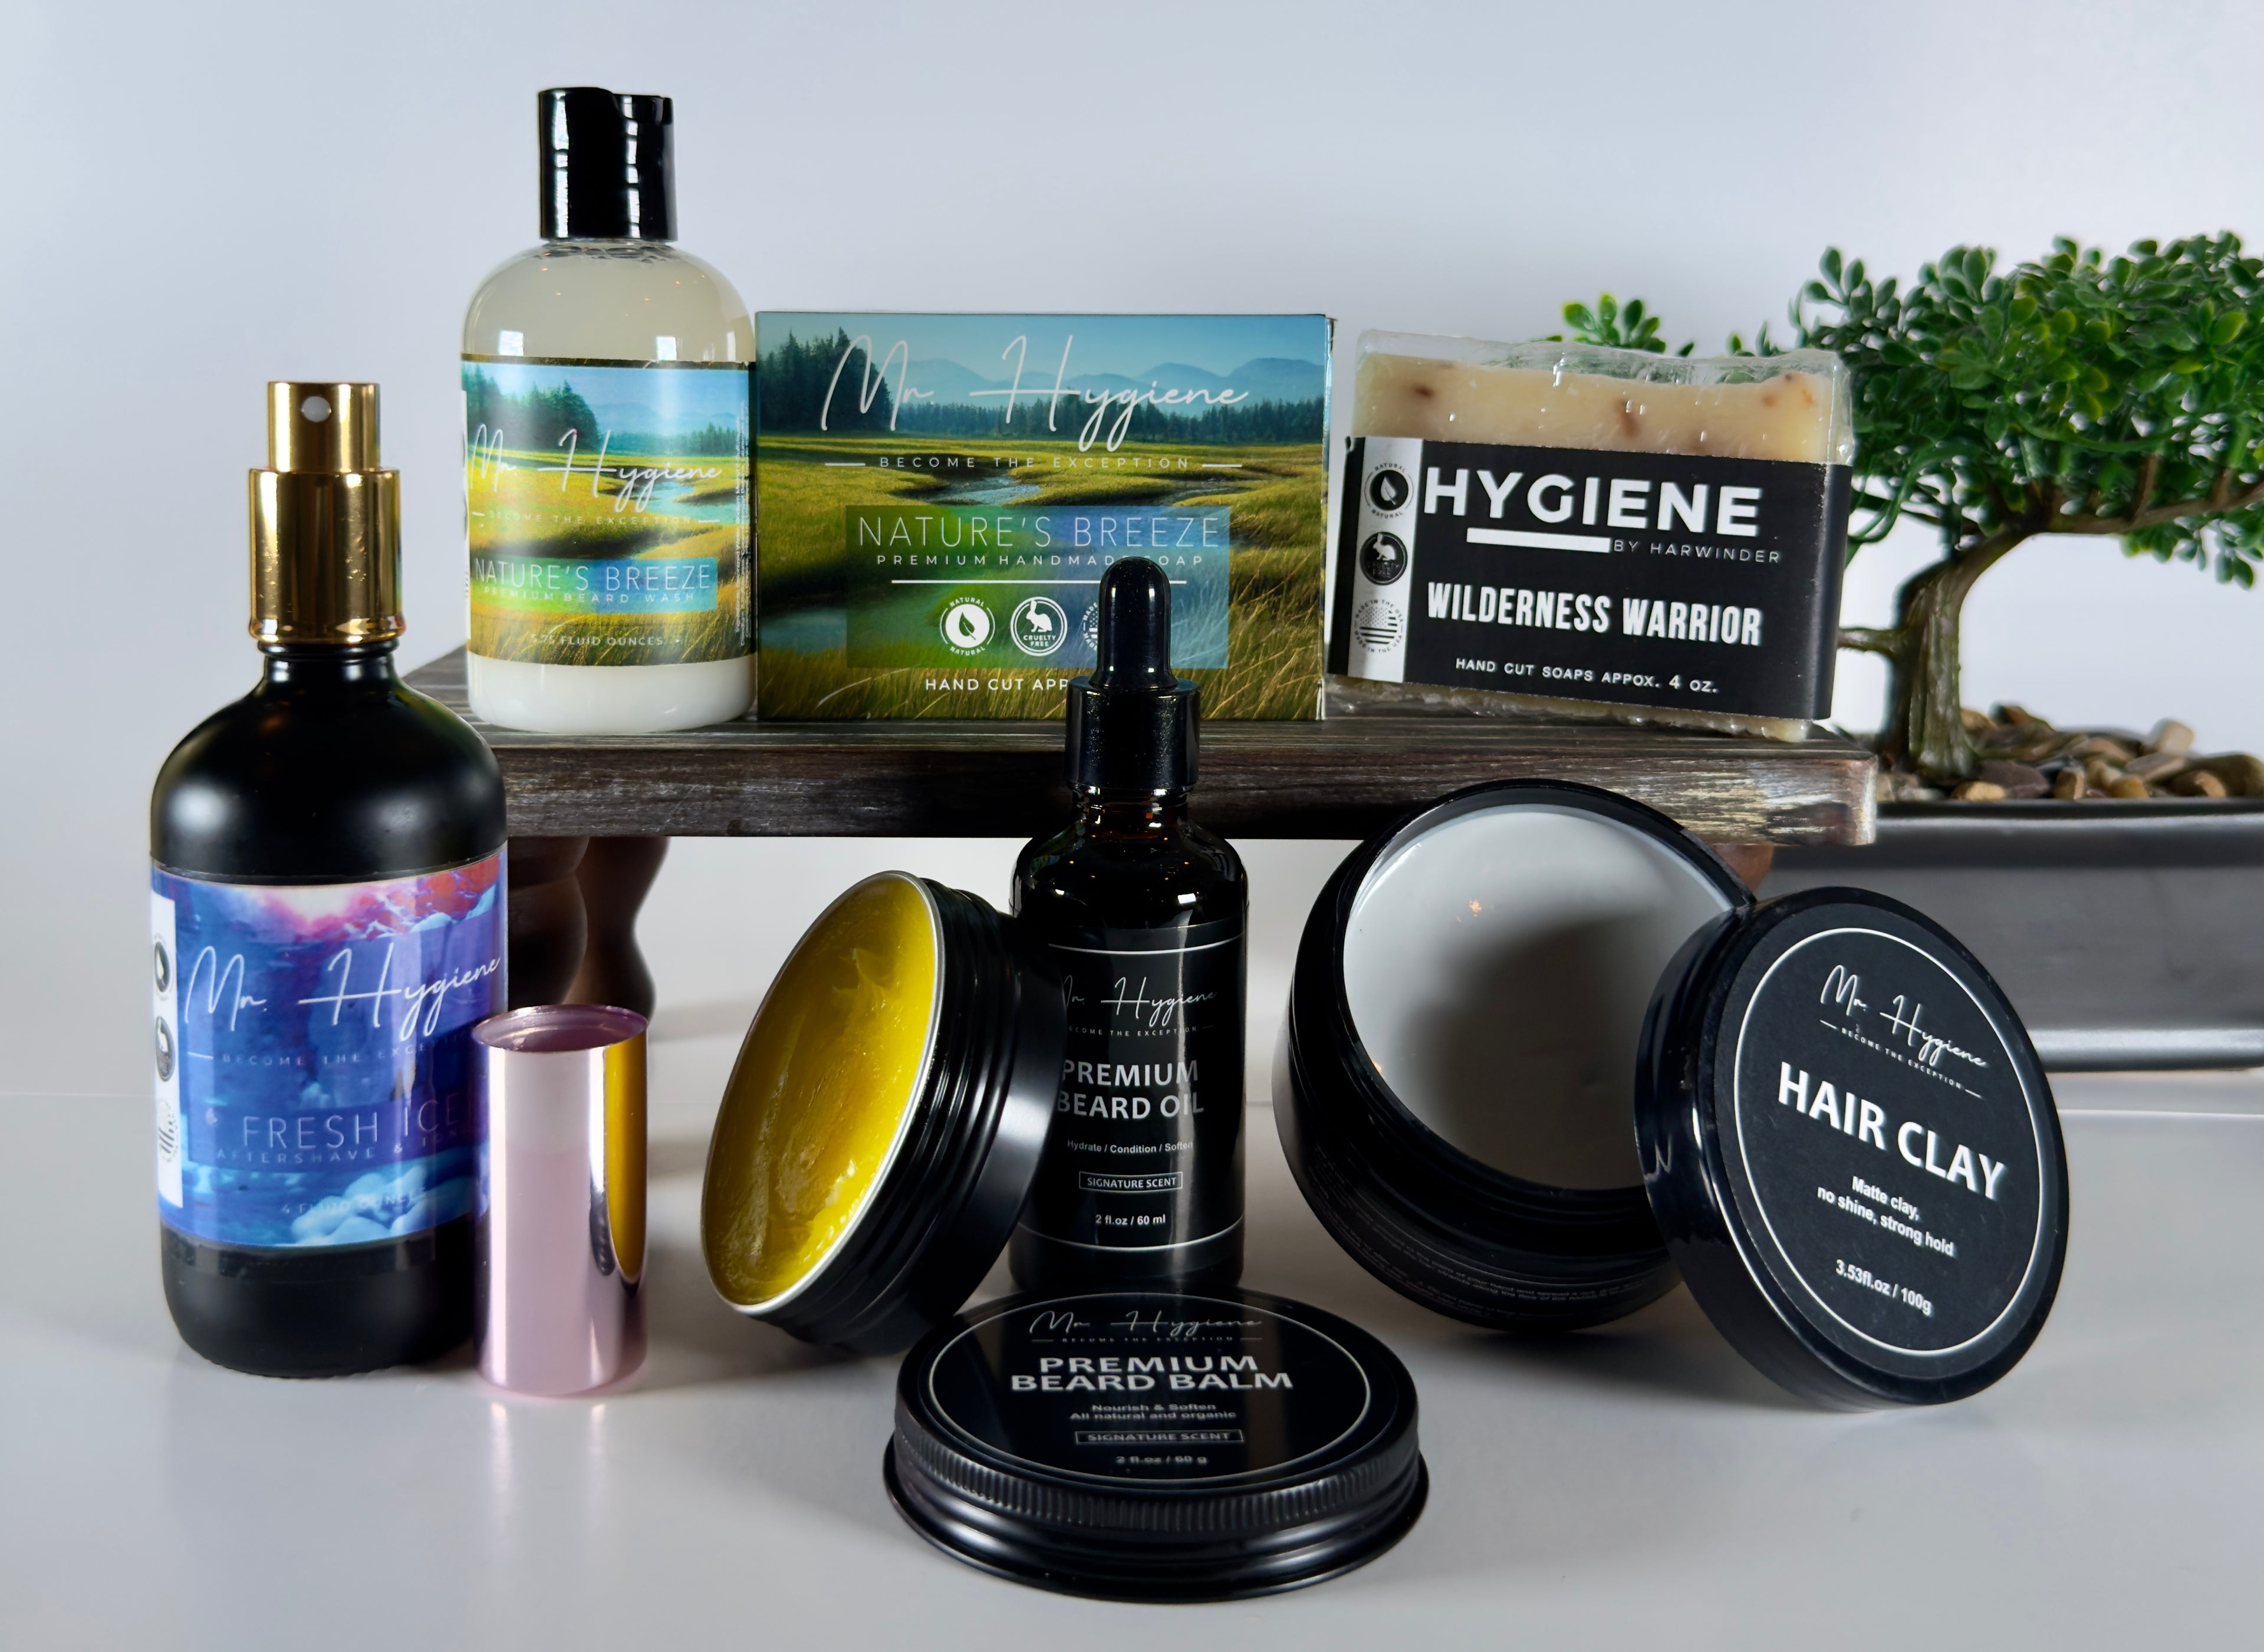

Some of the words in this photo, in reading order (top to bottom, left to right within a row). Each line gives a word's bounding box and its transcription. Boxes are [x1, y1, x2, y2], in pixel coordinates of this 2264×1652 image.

[821, 334, 934, 431] Mr.
[969, 334, 1249, 453] Hygiene
[470, 423, 517, 493] Mr.
[537, 429, 723, 513] Hygiene
[880, 456, 976, 468] BECOME
[993, 457, 1034, 469] THE
[1053, 457, 1189, 469] EXCEPTION
[1374, 463, 1406, 473] NATURAL
[1424, 467, 1762, 538] HYGIENE
[596, 516, 692, 525] EXCEPTION
[859, 516, 1051, 548] NATURE'S
[1075, 517, 1219, 547] BREEZE
[877, 555, 986, 565] PREMIUM
[999, 555, 1130, 565] HANDMAD
[1144, 555, 1202, 565] OAP
[1614, 539, 1640, 552] BY
[1650, 542, 1781, 564] HARWINDER
[474, 557, 589, 591] NATURE'S
[606, 564, 710, 591] BREEZE
[483, 586, 554, 600] PREMIUM
[564, 593, 630, 604] BEARD
[644, 592, 695, 603] WASH
[949, 597, 985, 608] NATURAL
[1427, 581, 1612, 633] WILDERNESS
[1622, 597, 1763, 647] WARRIOR
[559, 636, 602, 646] FLUID
[606, 636, 664, 646] OUNCES
[949, 646, 986, 656] NATURAL
[1455, 657, 1496, 673] HAND
[1503, 662, 1535, 676] CUT
[1541, 666, 1594, 682] SOAPS
[1601, 671, 1662, 689] APPOX.
[1669, 674, 1680, 689] 4
[925, 679, 979, 690] HAND
[988, 679, 1024, 690] CUT
[184, 945, 267, 1032] Mr.
[298, 942, 501, 1042] Hygiene
[1100, 976, 1216, 1027] Hygiene
[1820, 965, 1868, 1016] Mr.
[1879, 995, 1989, 1068] Hygiene
[1137, 1025, 1197, 1036] EXCEPTION
[223, 1053, 304, 1066] BECOME
[323, 1052, 360, 1064] THE
[1842, 1027, 1880, 1051] BECOME
[1885, 1048, 1903, 1061] THE
[1908, 1059, 1962, 1089] EXCEPTION
[1062, 1059, 1198, 1087] PREMIUM
[1057, 1091, 1151, 1119] BEARD
[1160, 1091, 1205, 1118] OIL
[243, 1112, 378, 1150] FRESH
[403, 1092, 461, 1137] ICE
[1778, 1061, 1887, 1151] HAIR
[1897, 1121, 2007, 1202] CLAY
[216, 1146, 375, 1164] AFTERSHAVE
[1067, 1139, 1102, 1153] Hydrate
[1110, 1144, 1157, 1154] Condition
[1164, 1140, 1194, 1152] Soften
[1087, 1177, 1144, 1188] SIGNATURE
[1146, 1177, 1177, 1188] SCENT
[1852, 1176, 1888, 1205] Matte
[1890, 1196, 1920, 1221] clay,
[281, 1203, 291, 1214] 4
[1095, 1215, 1102, 1224] 2
[1104, 1215, 1128, 1225] fl.oz
[1137, 1215, 1150, 1225] 60
[1153, 1213, 1166, 1224] ml
[1817, 1186, 1835, 1204] no
[1837, 1196, 1878, 1226] shine,
[1880, 1215, 1923, 1246] strong
[1925, 1231, 1956, 1258] hold
[1835, 1259, 1891, 1296] 3.53fl.oz
[1901, 1288, 1933, 1317] 100g
[1110, 1310, 1262, 1338] Hygiene
[1039, 1355, 1259, 1374] PREMIUM
[1011, 1375, 1156, 1391] BEARD
[1168, 1373, 1294, 1390] BALM
[1091, 1403, 1150, 1411] Nourish
[1168, 1403, 1217, 1411] Soften
[1094, 1412, 1145, 1420] natural
[1180, 1411, 1236, 1420] organic
[1087, 1433, 1178, 1442] SIGNATURE
[1180, 1432, 1231, 1441] SCENT
[1115, 1456, 1126, 1464] 2
[1197, 1456, 1208, 1465] g
